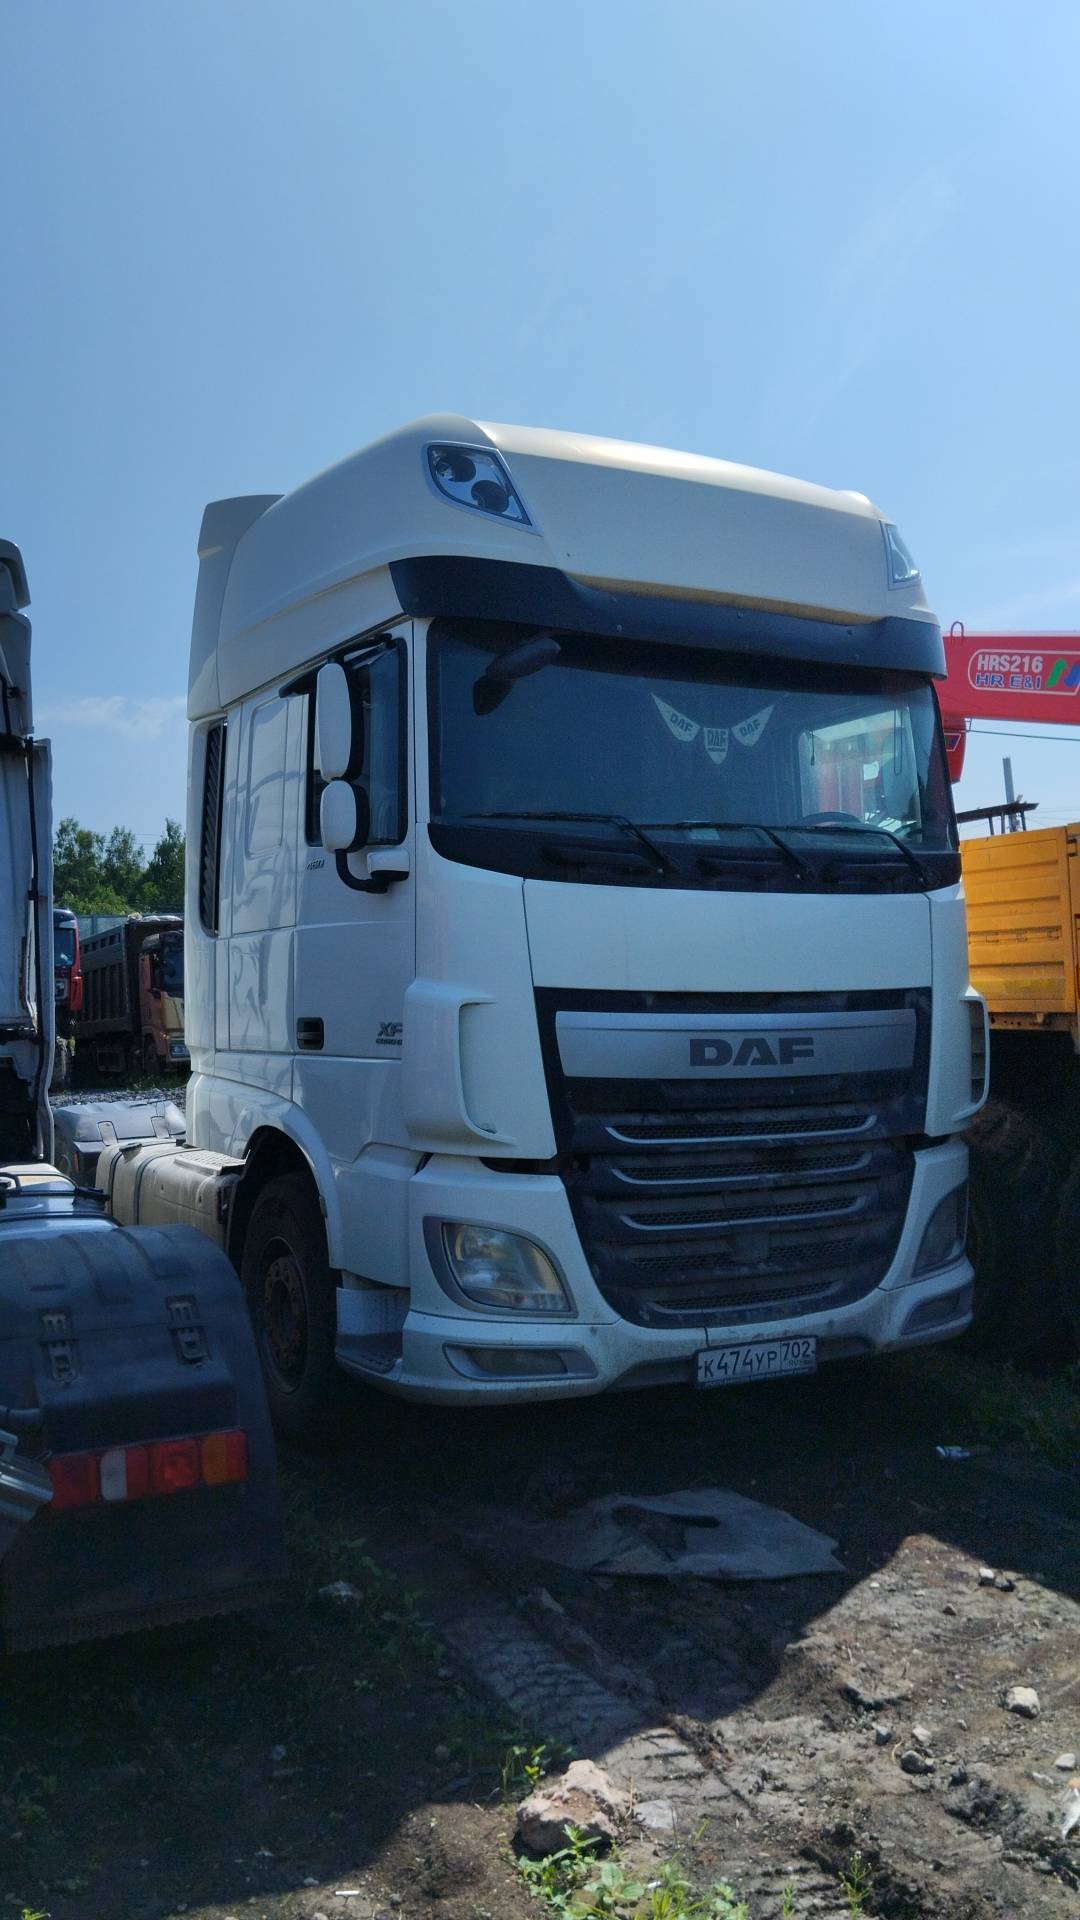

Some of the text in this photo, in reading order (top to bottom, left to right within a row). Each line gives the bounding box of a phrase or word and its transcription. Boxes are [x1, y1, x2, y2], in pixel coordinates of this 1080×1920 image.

[977, 654, 1043, 673] HRS216
[975, 672, 1042, 689] HR E&I
[669, 711, 693, 733] DAF
[740, 719, 761, 737] DAF
[707, 730, 727, 747] DAF
[378, 1022, 403, 1037] XF
[689, 1037, 815, 1067] DAF
[782, 1341, 811, 1361] 702
